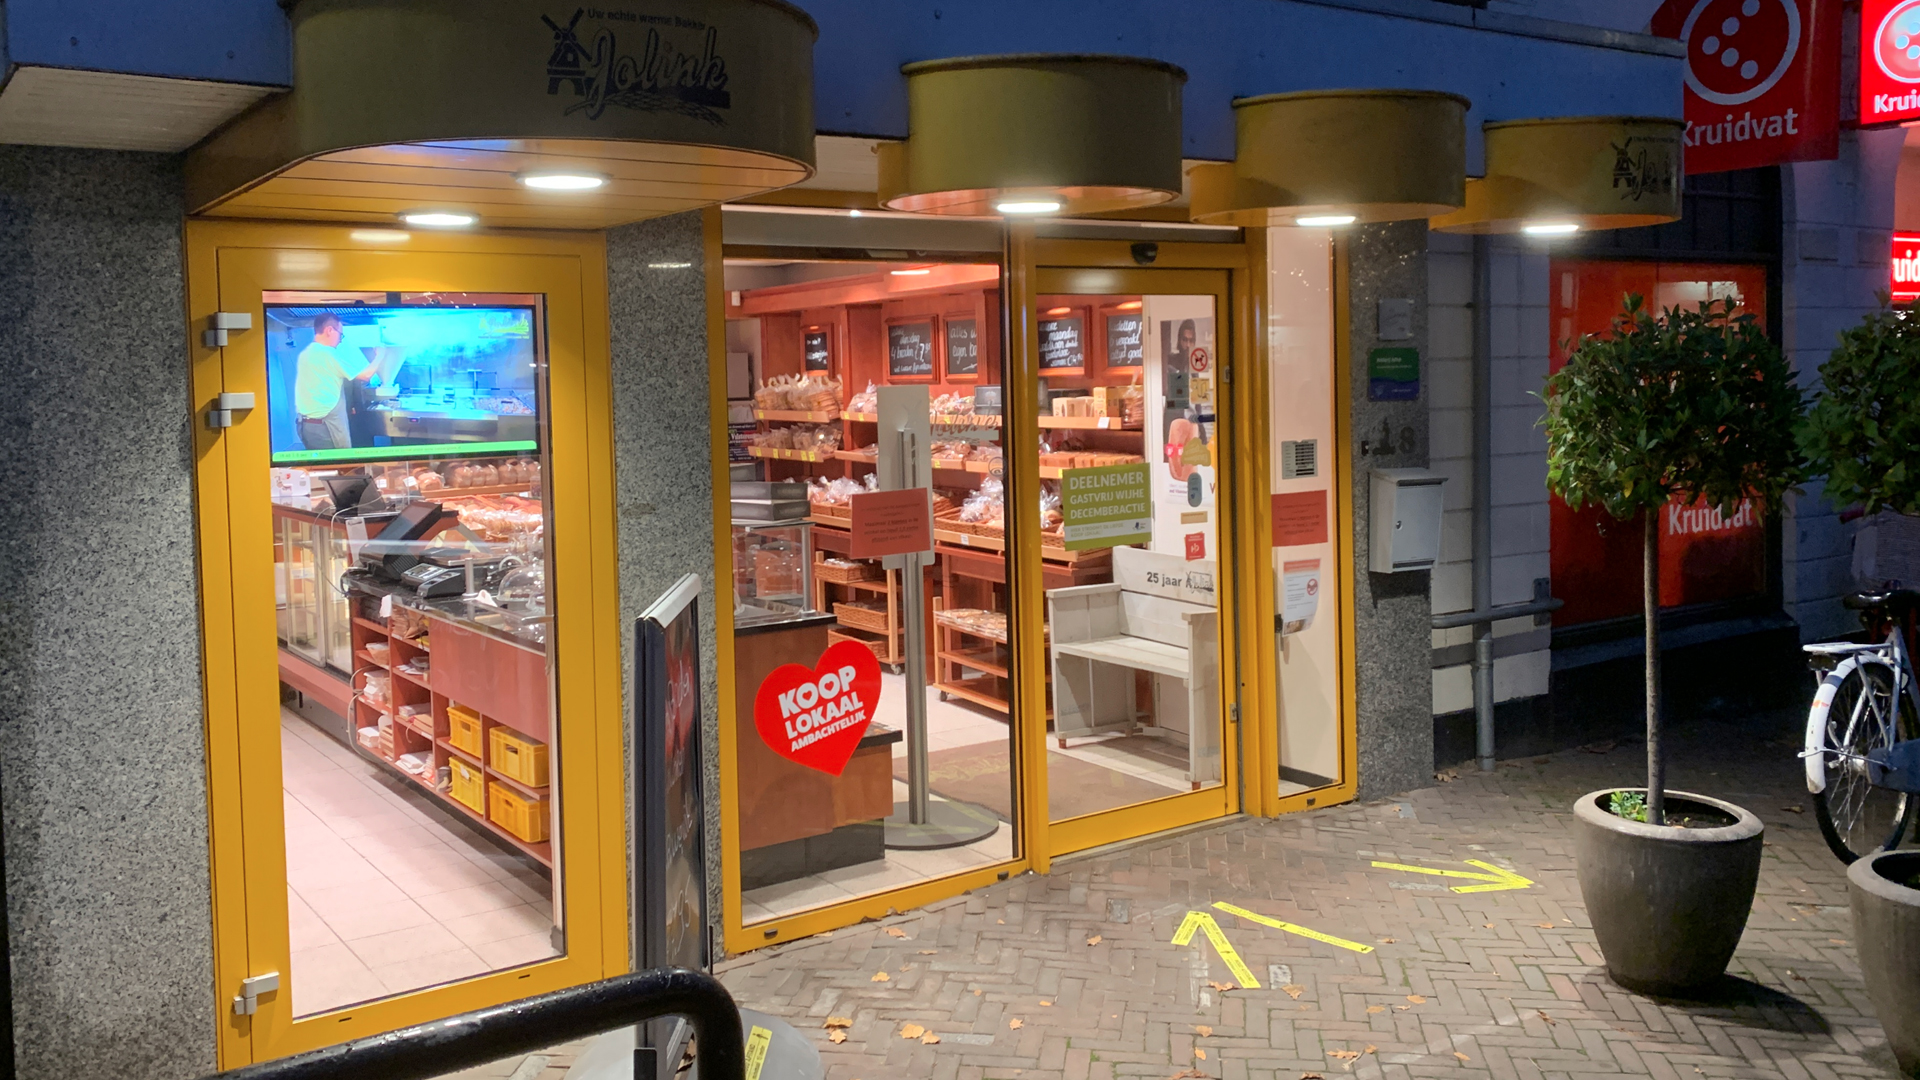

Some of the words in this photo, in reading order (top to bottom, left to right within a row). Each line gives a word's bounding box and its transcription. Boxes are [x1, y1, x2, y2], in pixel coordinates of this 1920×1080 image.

[588, 8, 604, 19] Uw
[608, 10, 636, 22] echte
[639, 13, 672, 25] warme
[674, 15, 706, 29] Bakker
[585, 26, 729, 120] Jolink
[1683, 108, 1799, 147] Kruidvat
[1069, 471, 1144, 490] DEELNEMER
[1070, 491, 1114, 505] GASTVRIJ
[1115, 488, 1144, 500] WIJHE
[1070, 503, 1145, 519] DECEMBERACTIE
[1147, 571, 1159, 584] 25
[1161, 574, 1182, 587] jaar
[778, 665, 856, 719] KOOP
[785, 691, 864, 739] LOKAAL
[791, 710, 867, 752] AMBACHTELIJK
